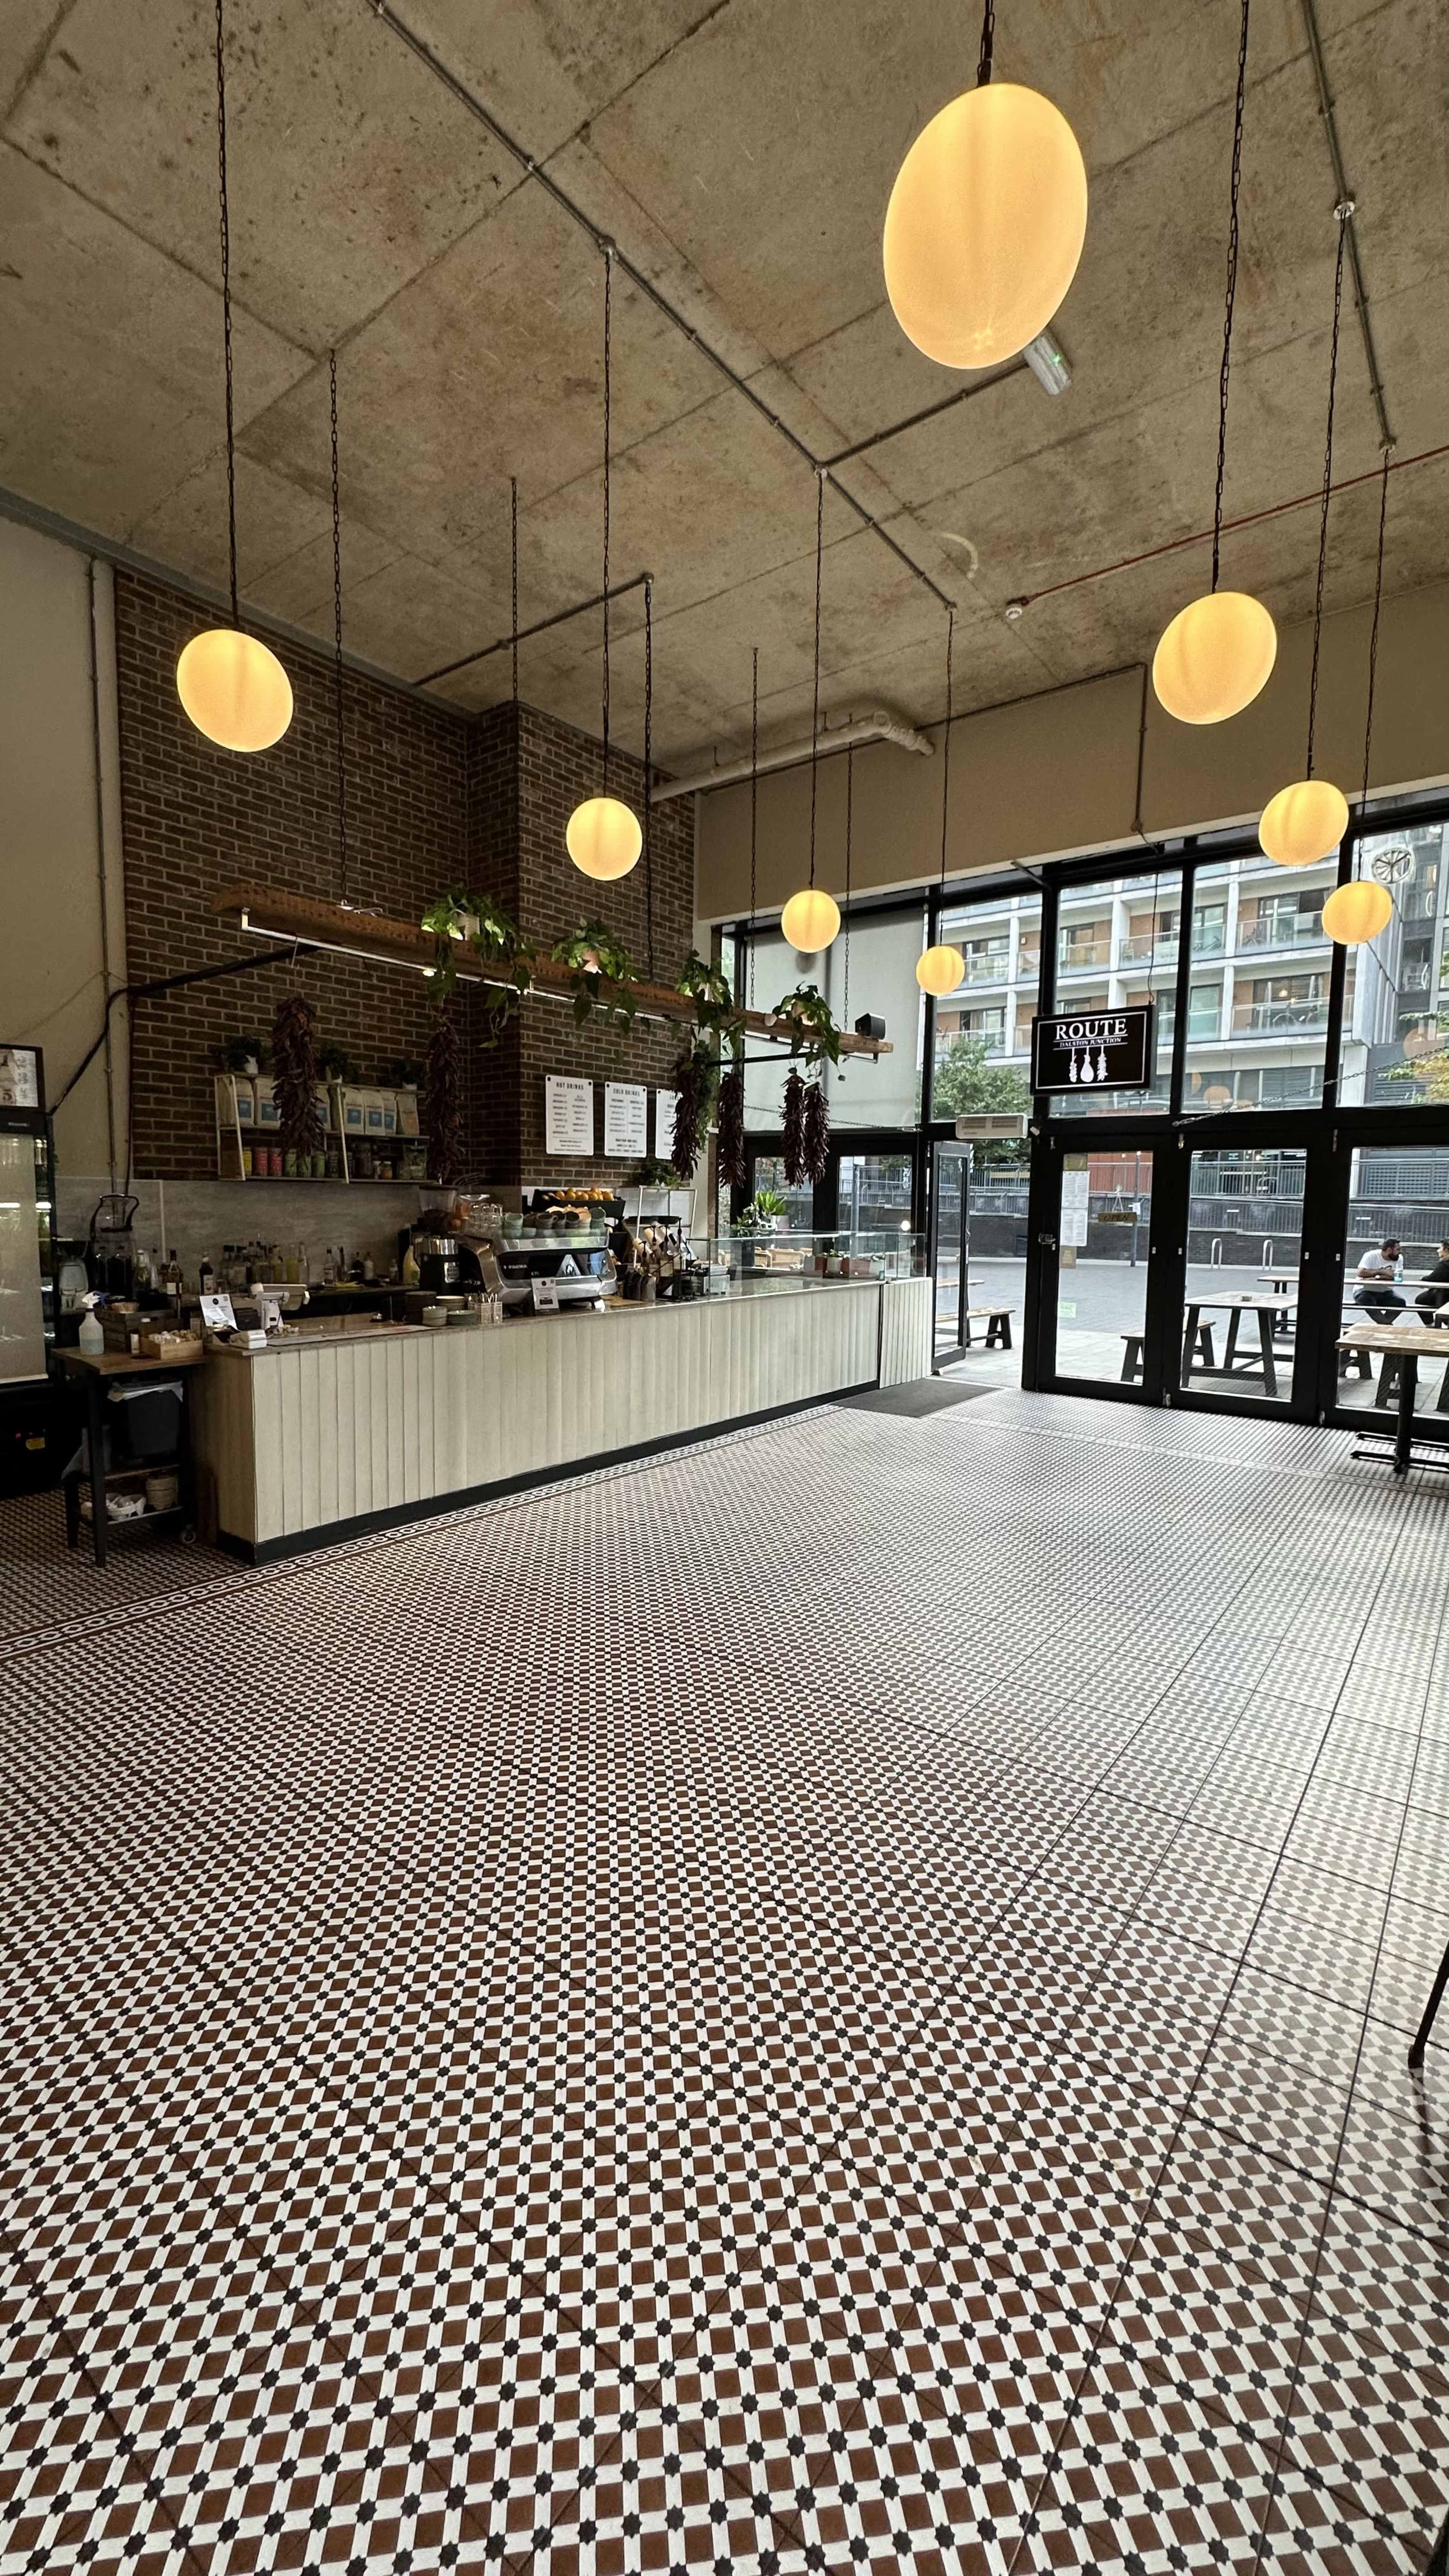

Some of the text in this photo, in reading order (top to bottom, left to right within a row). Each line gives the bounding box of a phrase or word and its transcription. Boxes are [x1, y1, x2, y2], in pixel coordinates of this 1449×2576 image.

[1055, 1018, 1127, 1040] ROUTE
[1060, 1037, 1121, 1048] DALSTON JUNCTION
[1104, 1213, 1129, 1221] OPEN
